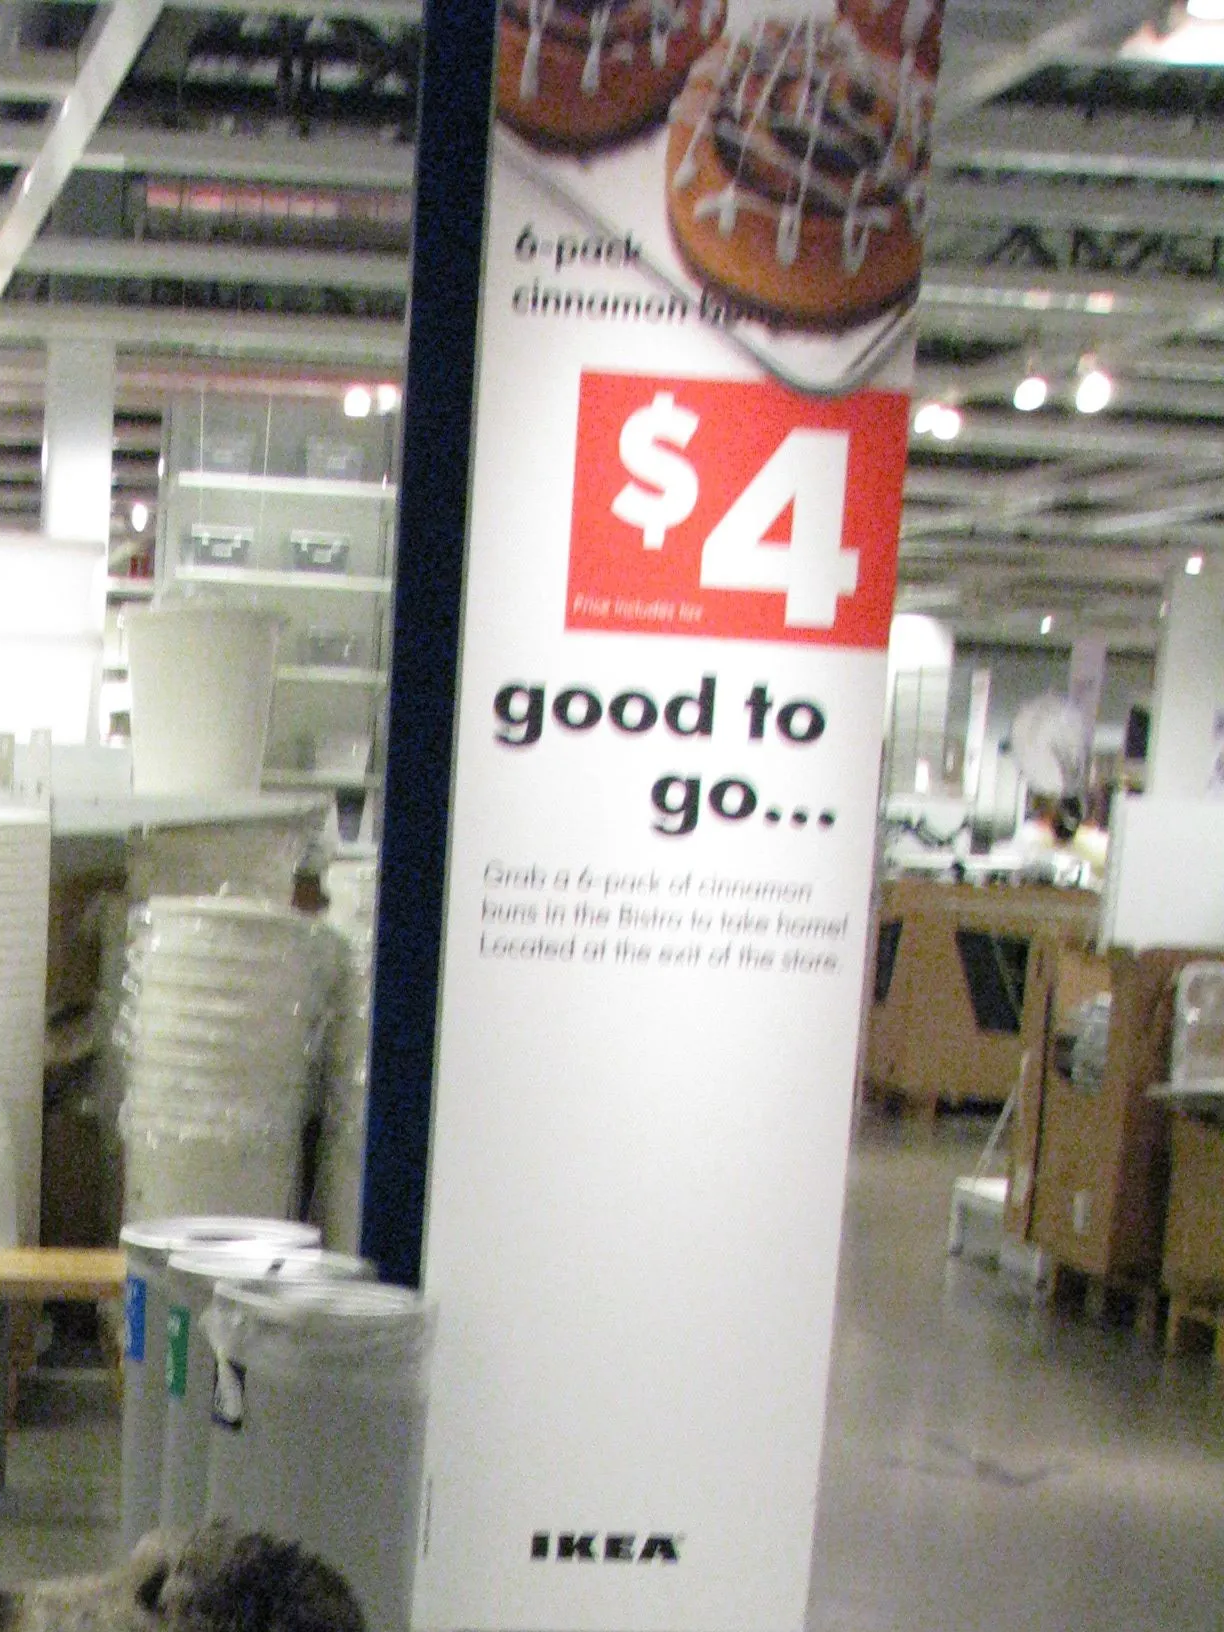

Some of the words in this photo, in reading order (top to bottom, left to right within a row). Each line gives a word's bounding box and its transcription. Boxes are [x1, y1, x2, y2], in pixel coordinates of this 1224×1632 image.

[514, 223, 642, 273] 6-pack
[511, 277, 688, 324] cinnamon
[492, 670, 717, 748] good
[744, 682, 826, 744] to
[650, 771, 837, 838] go...
[483, 859, 546, 892] Grab
[553, 869, 570, 892] a
[577, 864, 659, 898] 6-pack
[668, 871, 692, 897] of
[698, 873, 813, 904] cinnamon
[481, 897, 536, 926] buns
[544, 900, 566, 927] in
[574, 901, 610, 929] the
[618, 902, 682, 932] Bistro
[691, 908, 712, 936] to
[720, 908, 769, 938] take
[479, 931, 576, 964] Located
[583, 937, 607, 964] at
[615, 936, 652, 967] the
[657, 941, 701, 969] exit
[707, 939, 732, 972] of
[738, 942, 775, 973] the
[529, 1531, 688, 1565] IKEA
